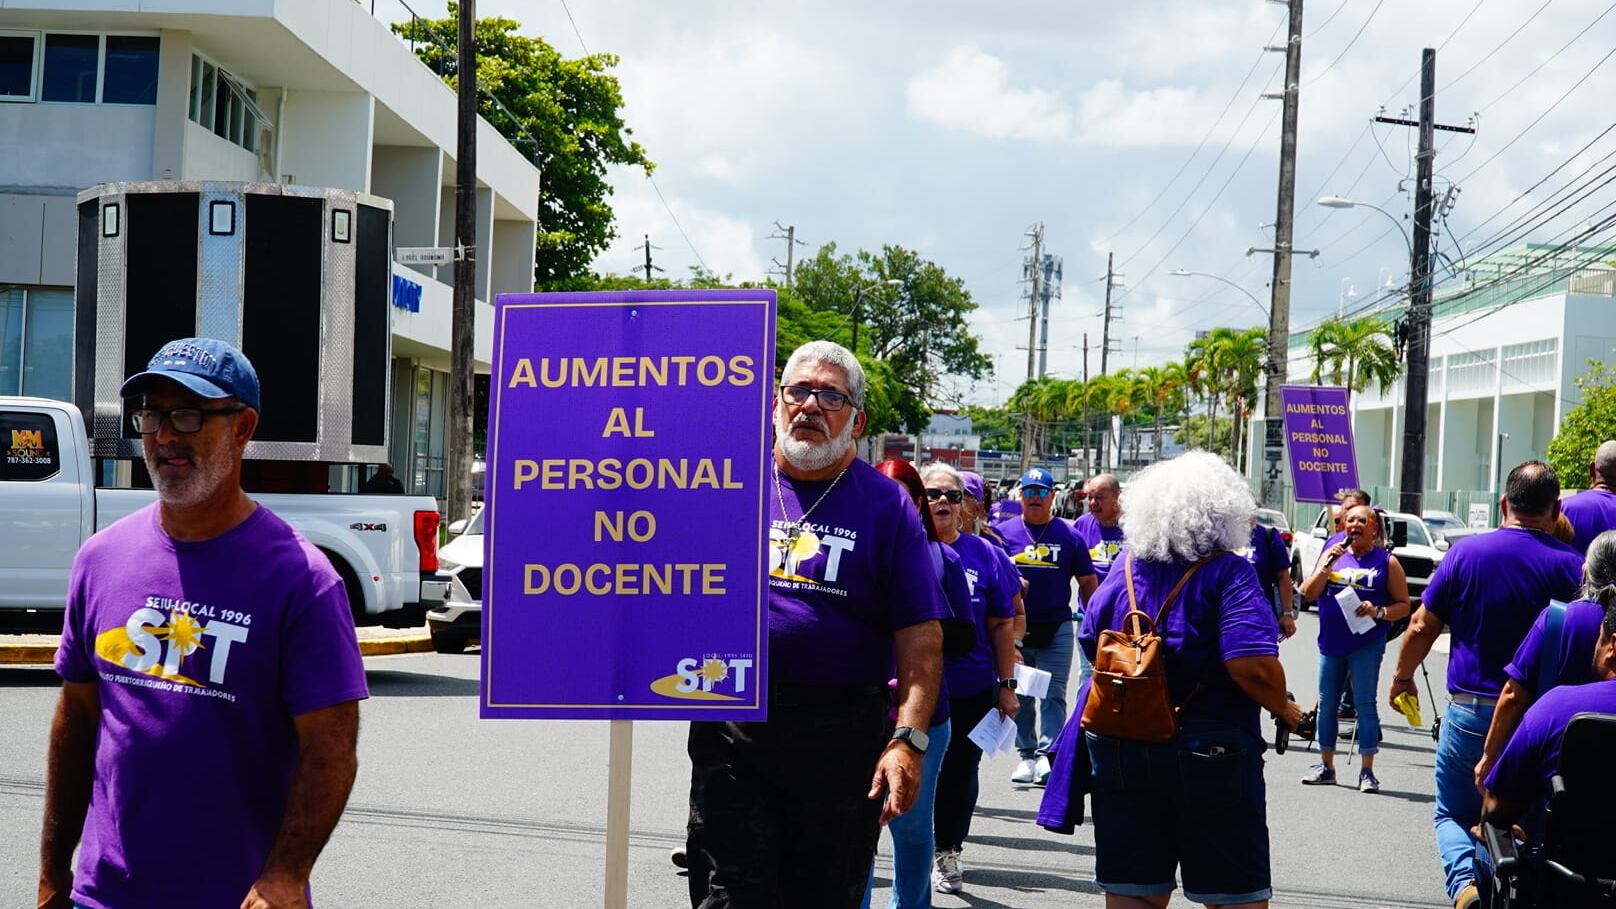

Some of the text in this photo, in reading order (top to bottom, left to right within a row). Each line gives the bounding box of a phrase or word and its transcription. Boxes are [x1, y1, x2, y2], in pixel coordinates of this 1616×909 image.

[508, 355, 755, 388] AUMENTOS
[1286, 403, 1346, 415] AUMENTOS
[602, 407, 655, 438] AL
[1311, 419, 1324, 429] AL
[1291, 432, 1348, 444] PERSONAL
[1312, 448, 1329, 458] NO
[513, 457, 744, 490] PERSONAL
[1298, 461, 1348, 473] DOCENTE
[593, 510, 657, 542] NO
[833, 527, 857, 540] 1996
[523, 563, 727, 595] DOCENTE
[801, 583, 848, 597] TRABAJADORES
[145, 596, 252, 625] SEIU-LOCAL 1996
[122, 608, 249, 684] SPT
[675, 658, 753, 693] SPT
[173, 684, 183, 692] DE
